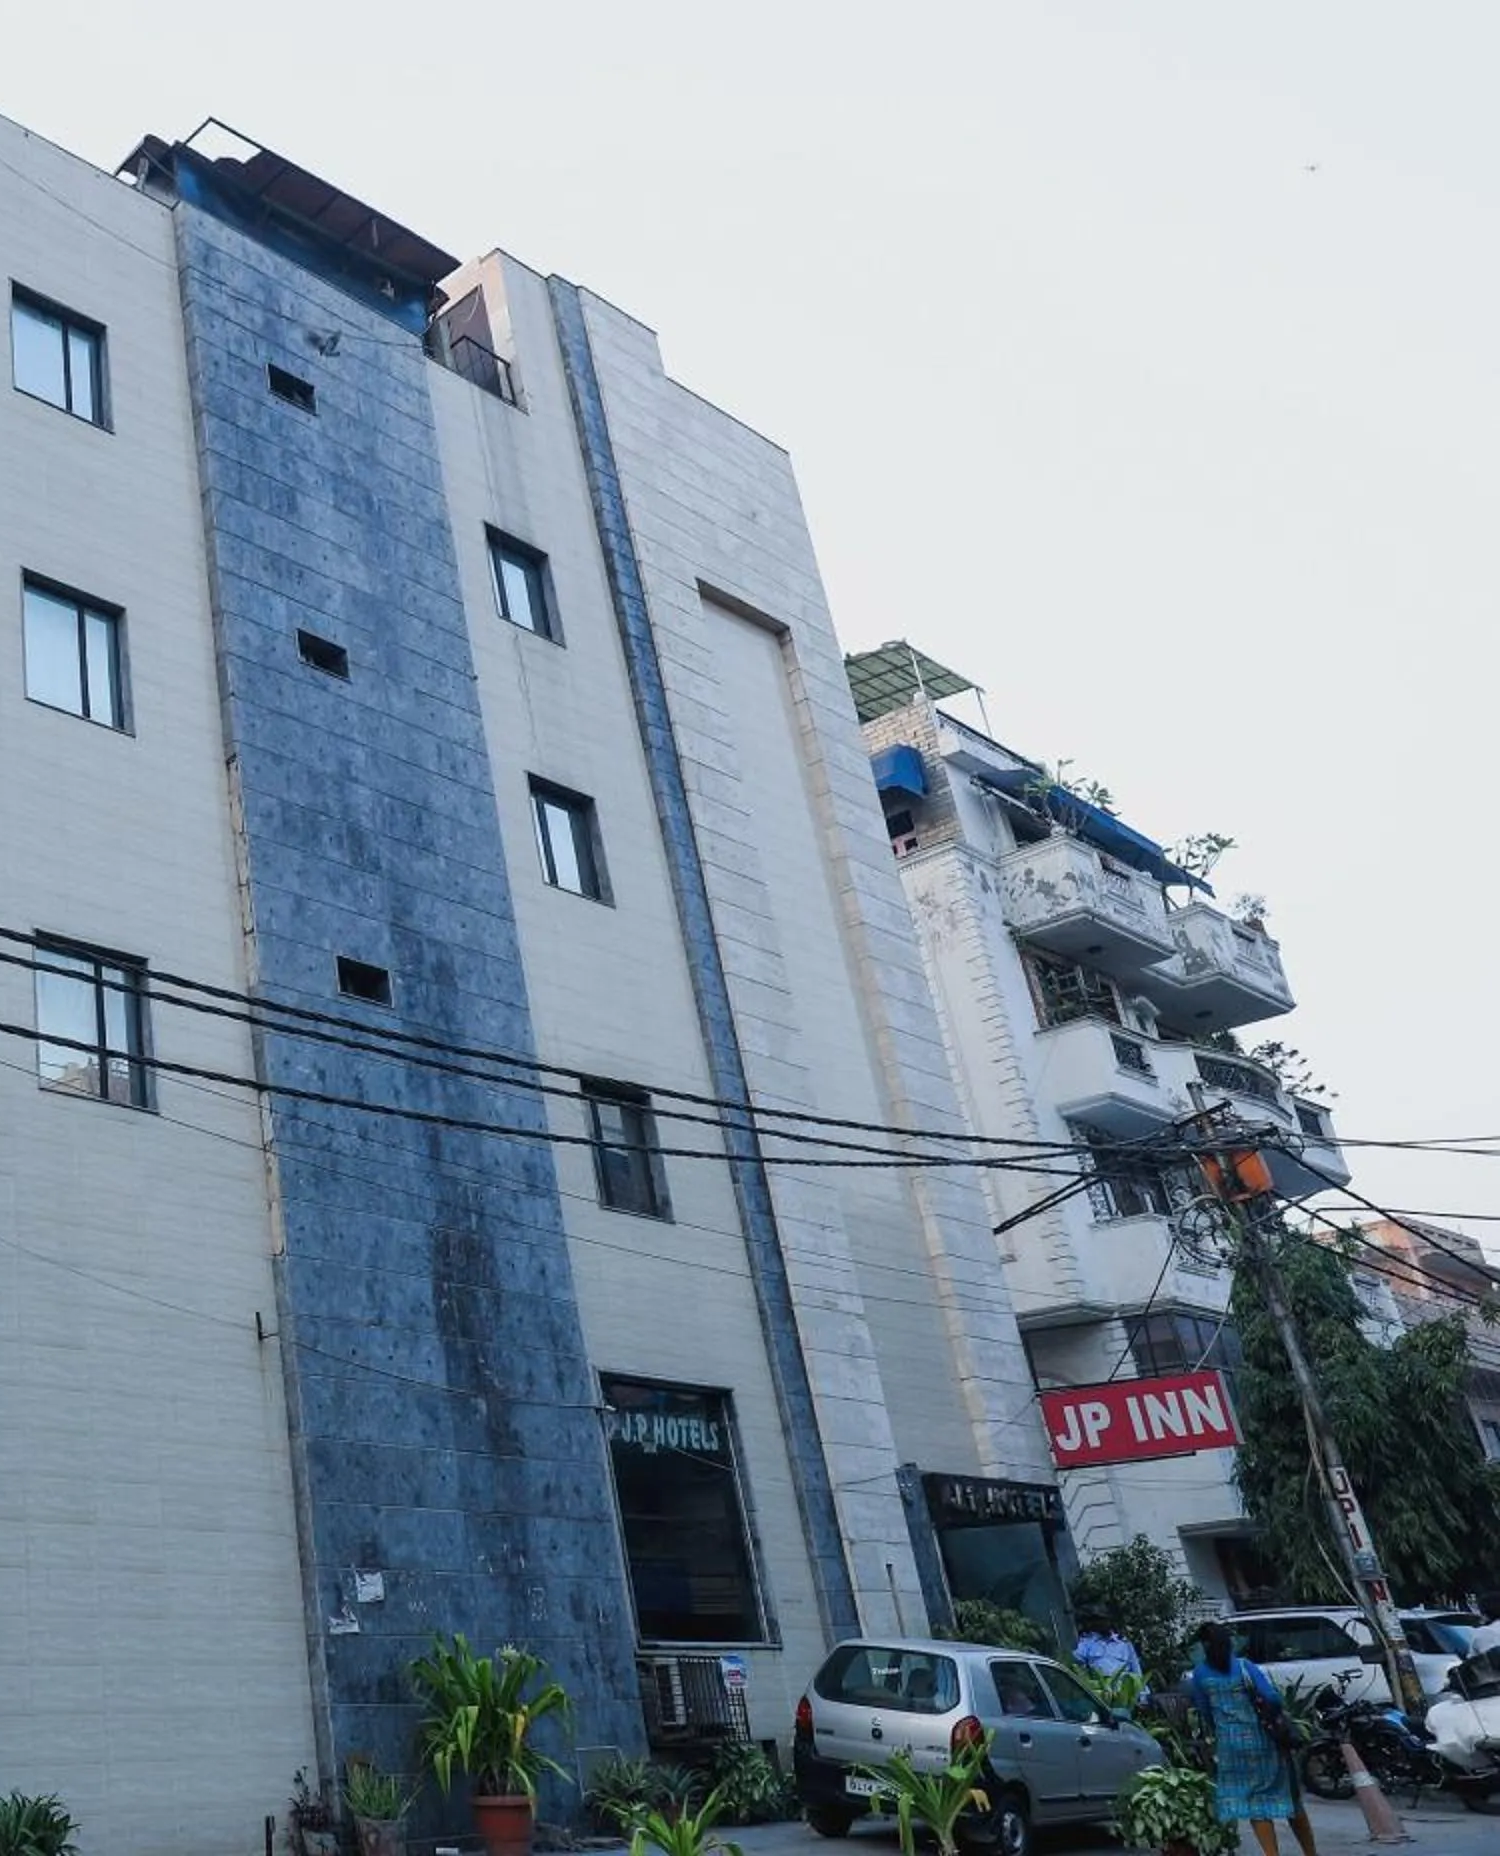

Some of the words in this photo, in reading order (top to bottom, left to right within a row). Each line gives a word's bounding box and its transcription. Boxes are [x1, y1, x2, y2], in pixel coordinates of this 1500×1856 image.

[653, 1415, 719, 1451] HOTELS
[1055, 1401, 1111, 1451] JP
[1125, 1385, 1229, 1443] INN
